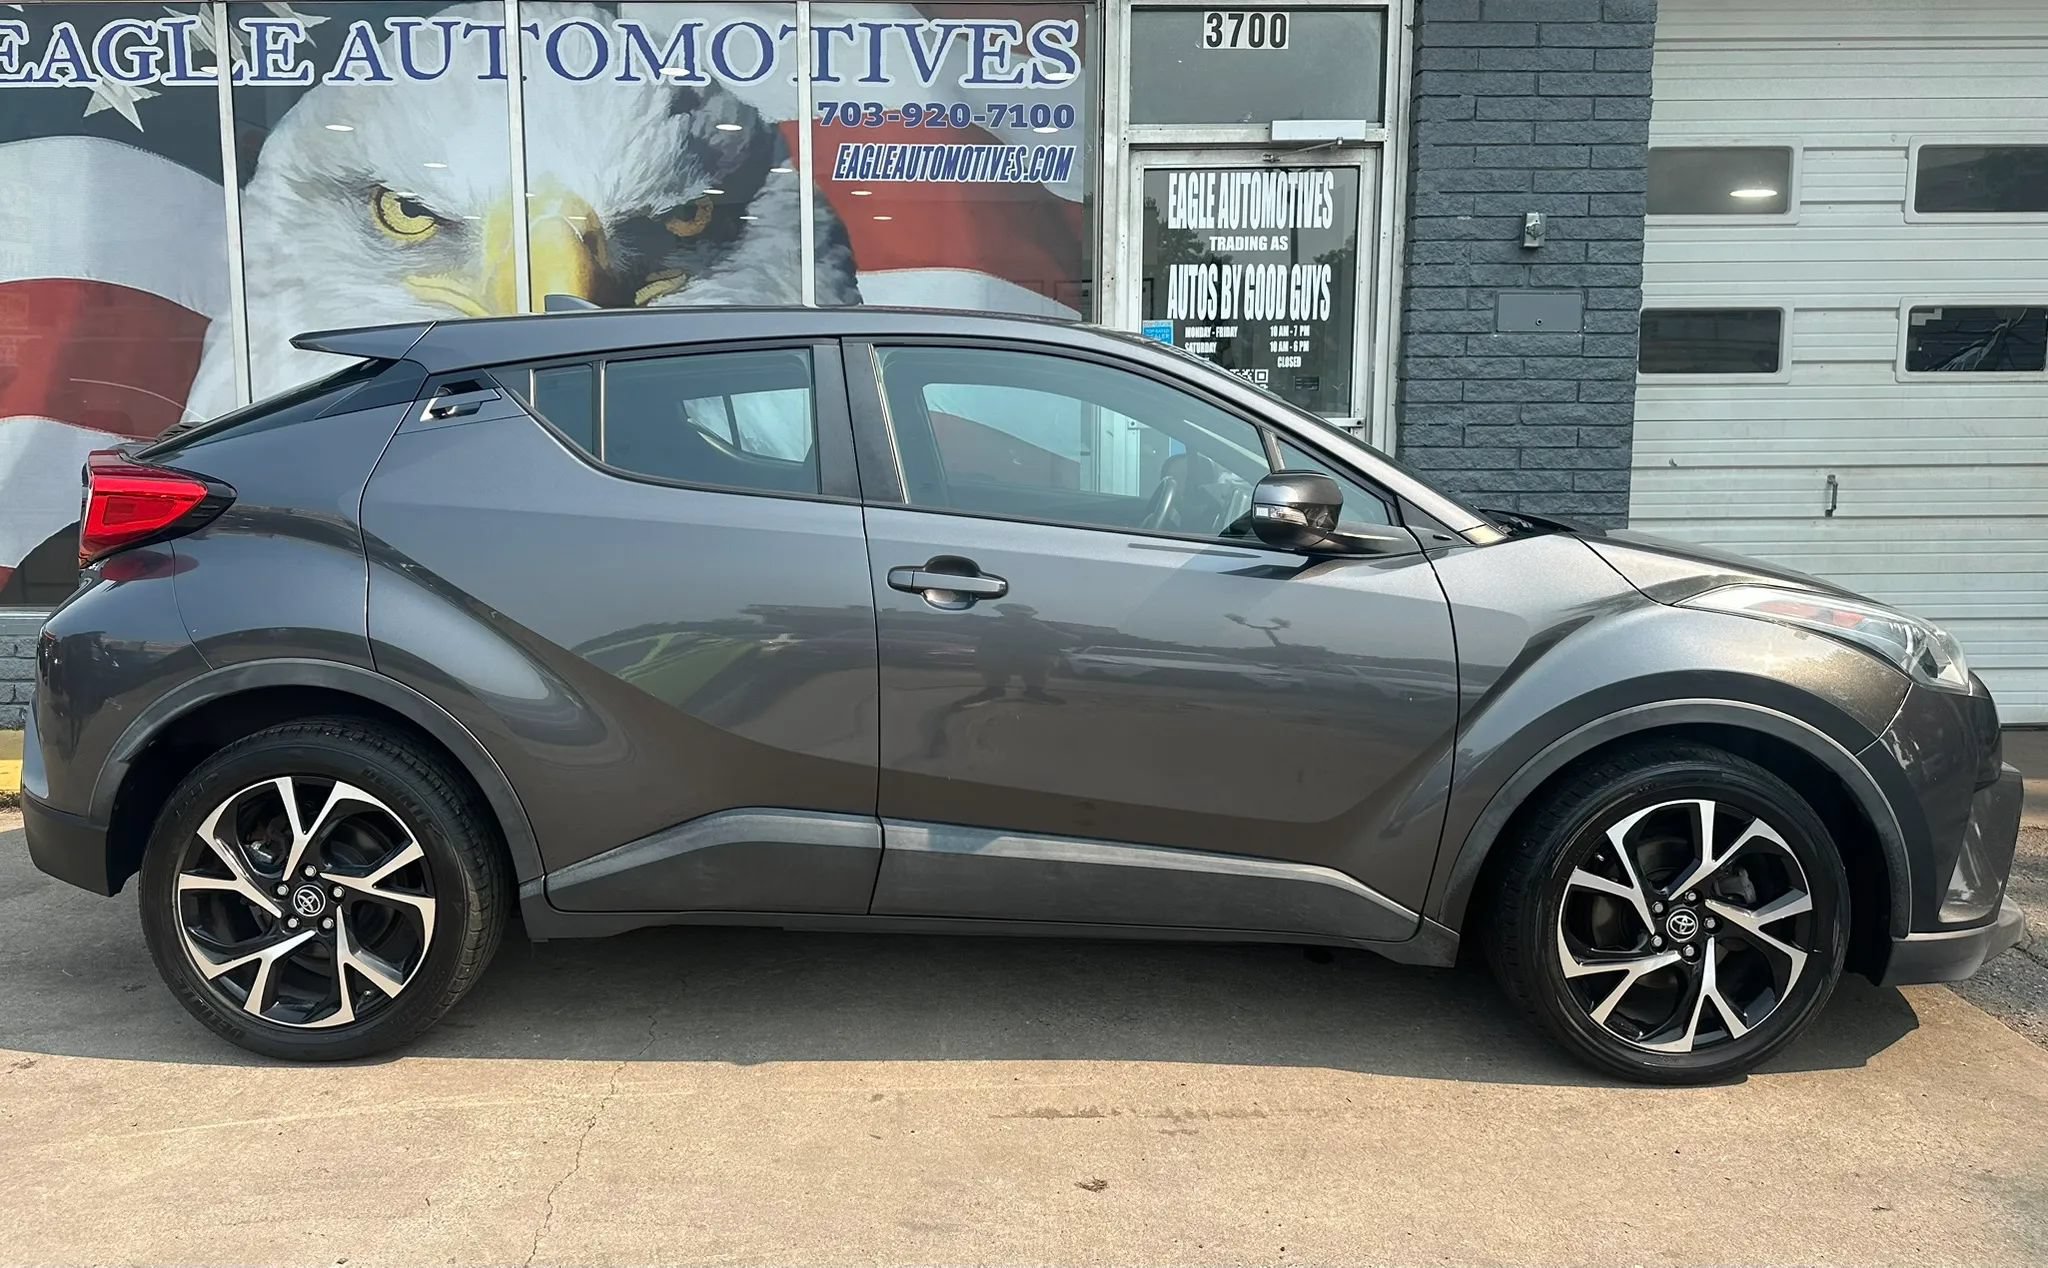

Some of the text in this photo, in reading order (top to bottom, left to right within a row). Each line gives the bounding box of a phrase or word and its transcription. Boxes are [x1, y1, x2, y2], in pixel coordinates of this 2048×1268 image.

[1206, 13, 1287, 48] 3700
[323, 18, 1080, 88] AUTOMOTIVES
[817, 101, 1075, 129] 703-920-7100
[832, 143, 1077, 182] EAGLEAUTOMOTIVES.COM
[1168, 171, 1334, 230] EAGLE AUTOMOTIVES
[1209, 235, 1288, 251] TRADING AS
[1167, 264, 1332, 321] AUTOS BY GOOD GUYS
[1185, 326, 1211, 338] MONDAY
[1216, 326, 1238, 338] FRIDAY
[1270, 325, 1278, 337] 10
[1279, 325, 1289, 337] AM
[1293, 325, 1298, 336] 7
[1300, 325, 1310, 336] PM
[1185, 342, 1217, 353] SATURDAY
[1269, 341, 1278, 352] 10
[1278, 341, 1289, 352] AM
[1293, 340, 1298, 352] 6
[1299, 340, 1310, 352] PM
[1277, 356, 1302, 368] CLOSED
